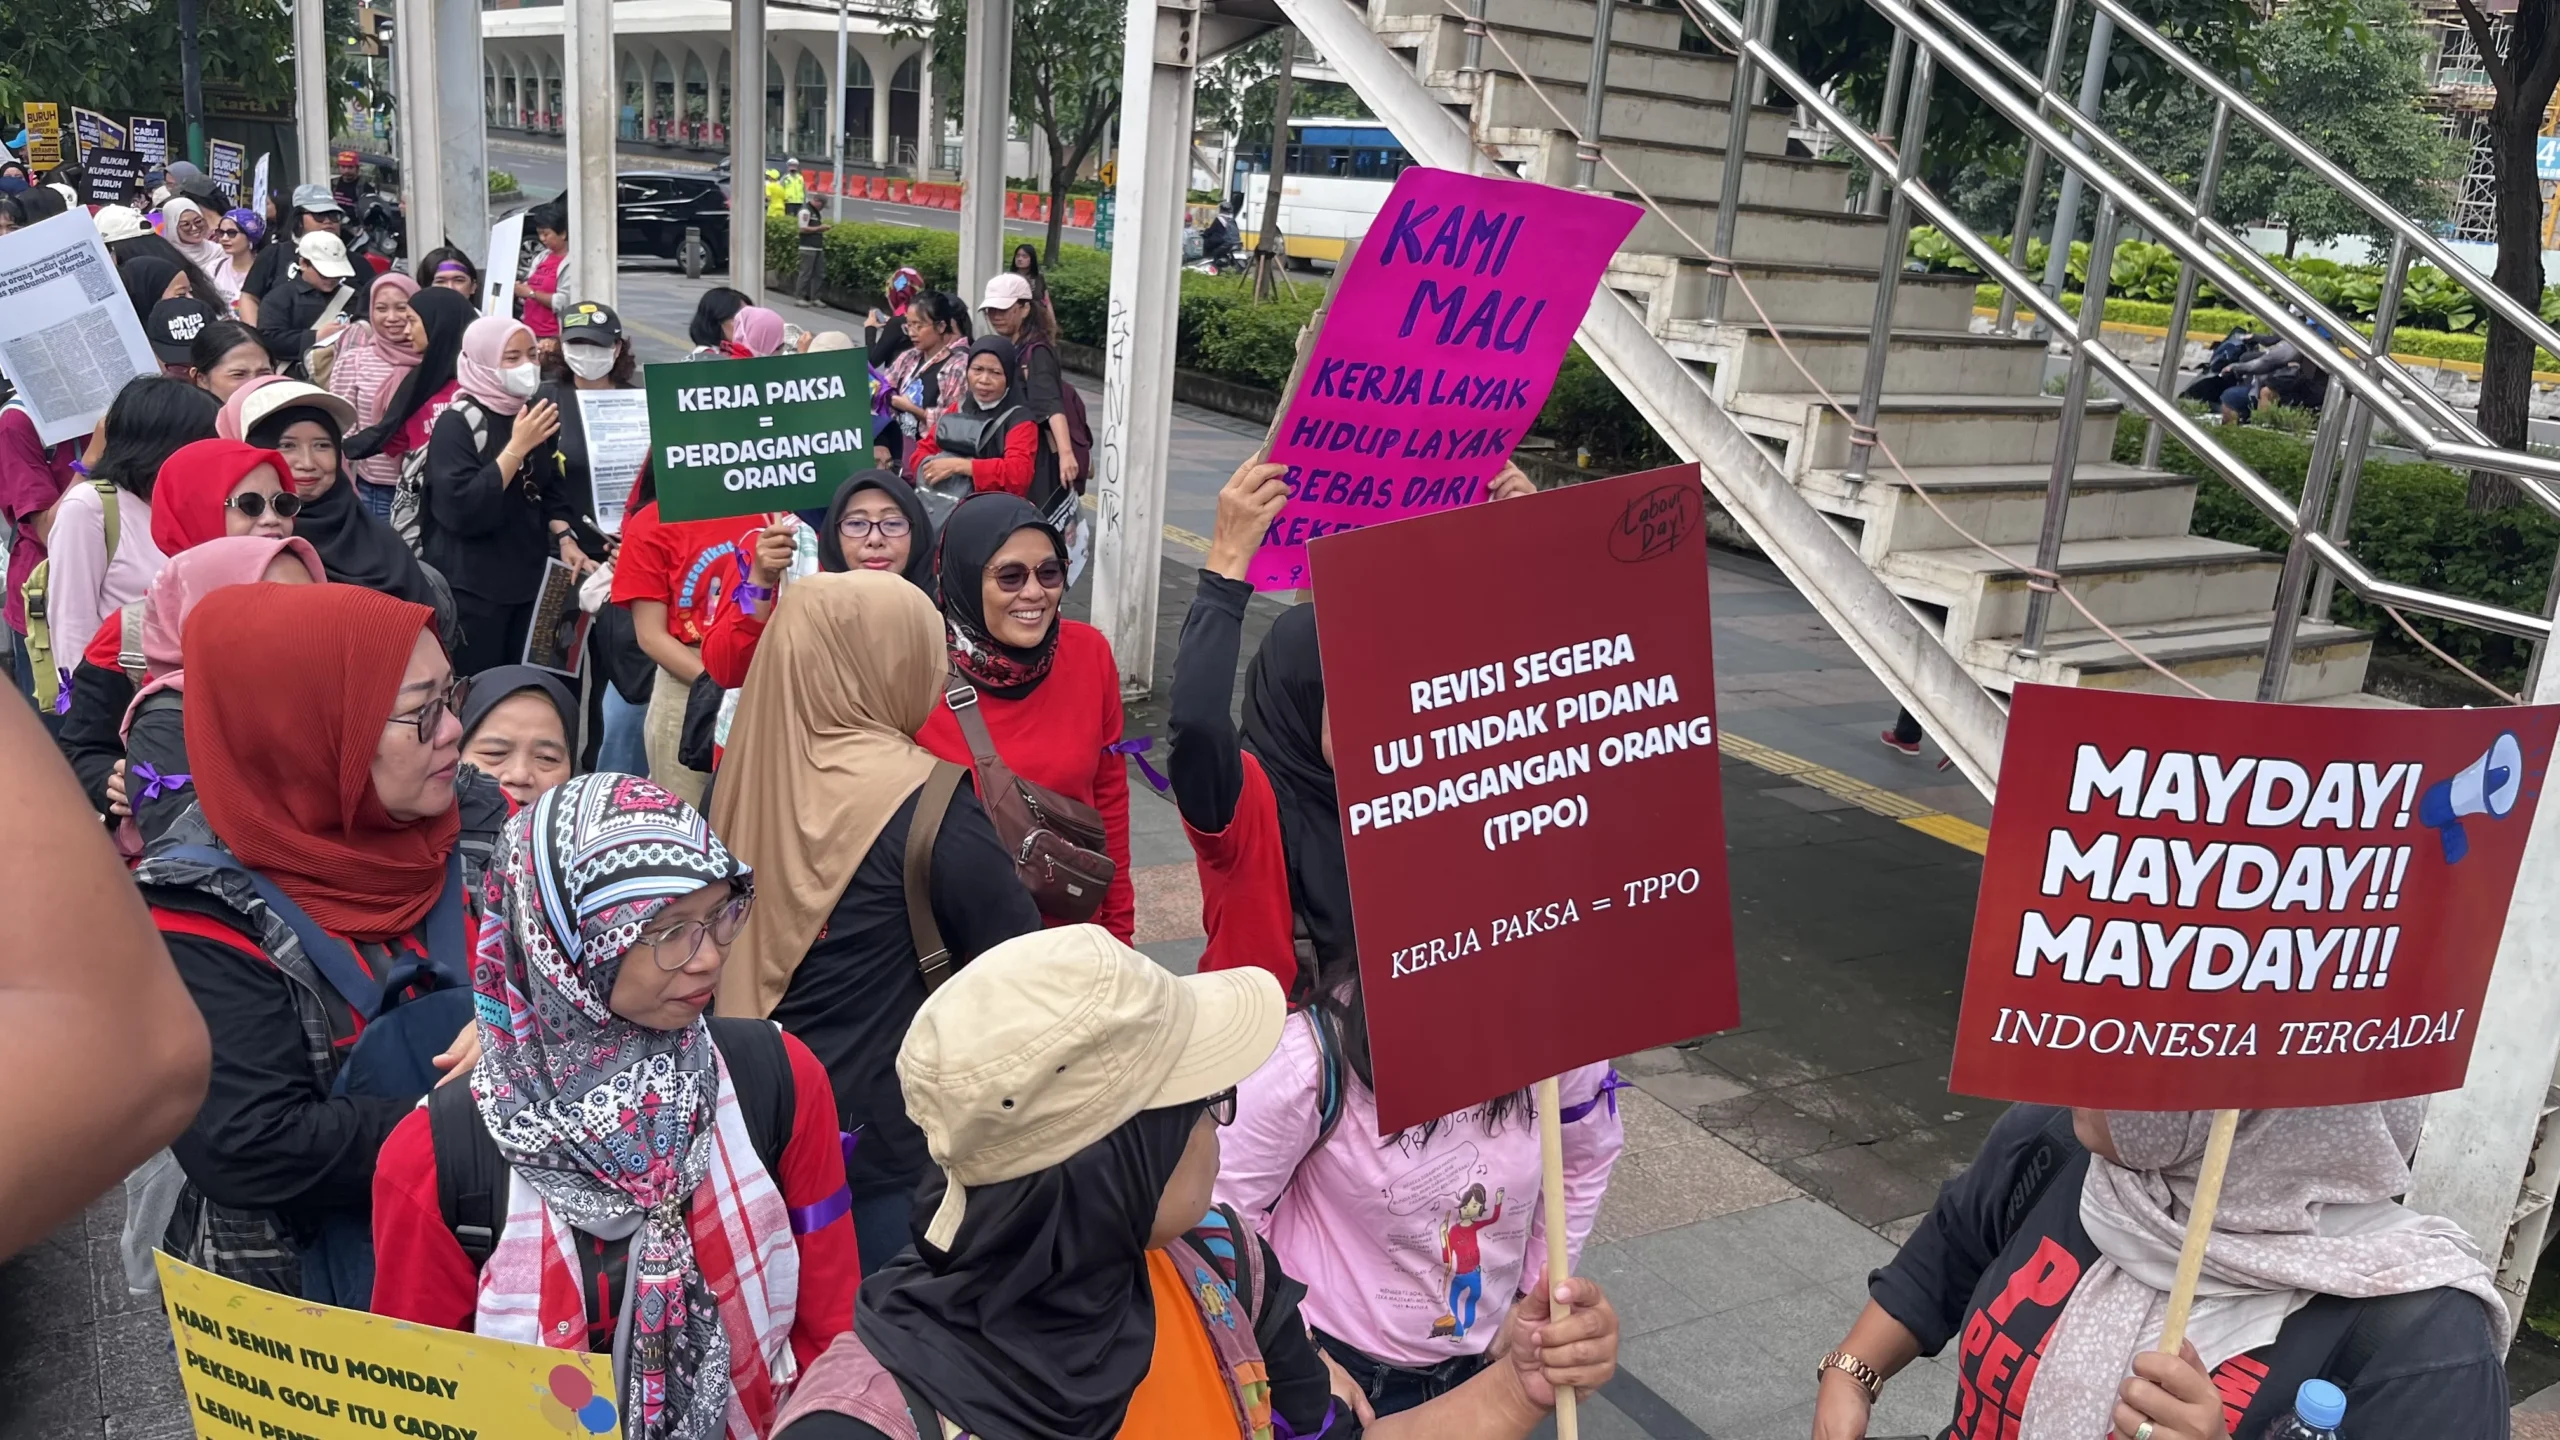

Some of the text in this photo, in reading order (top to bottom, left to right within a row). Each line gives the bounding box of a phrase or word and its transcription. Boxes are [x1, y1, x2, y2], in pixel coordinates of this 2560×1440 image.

[27, 110, 56, 123] BURUH
[133, 127, 159, 137] CABUT
[88, 166, 135, 178] KUMPULAN
[92, 178, 122, 189] BURUH
[100, 156, 130, 166] BUKAN
[213, 159, 240, 172] BURUH
[92, 190, 120, 200] ISTANA
[1380, 198, 1525, 278] KAMI
[8, 271, 60, 296] pembunuhan
[60, 255, 96, 275] Marsinah
[9, 270, 34, 285] orang
[33, 261, 59, 276] hadiri
[59, 251, 85, 266] sidang
[1399, 280, 1546, 354] MAU
[677, 375, 846, 412] KERJA PAKSA
[1311, 357, 1530, 411] KERJA LAYAK
[759, 416, 774, 427] =
[1290, 416, 1512, 460] HIDUP LAYAK
[666, 428, 863, 469] PERDAGANGAN
[723, 461, 816, 492] ORANG
[1283, 465, 1480, 509] BEBAS DARI
[1642, 504, 1686, 552] Day!
[678, 540, 735, 608] Berserikat
[1409, 633, 1635, 714] REVISI SEGERA
[1373, 674, 1679, 776] UU TINDAK PIDANA
[1348, 716, 1711, 837] PERDAGANGAN ORANG
[2067, 743, 2423, 829] MAYDAY!
[1482, 794, 1588, 852] (TPPO)
[2040, 828, 2411, 911] MAYDAY!!
[1390, 867, 1702, 979] KERJA PAKSA = TPPO
[2013, 909, 2400, 992] MAYDAY!!!
[1991, 1008, 2465, 1057] INDONESIA TERGADAI
[2005, 1145, 2052, 1236] CHIBA
[173, 1302, 458, 1400] HARI SENIN ITU MONDAY
[185, 1349, 274, 1401] PEKERJA
[279, 1386, 340, 1418] GOLF
[347, 1403, 387, 1429] ITU
[195, 1392, 254, 1434] LEBIH
